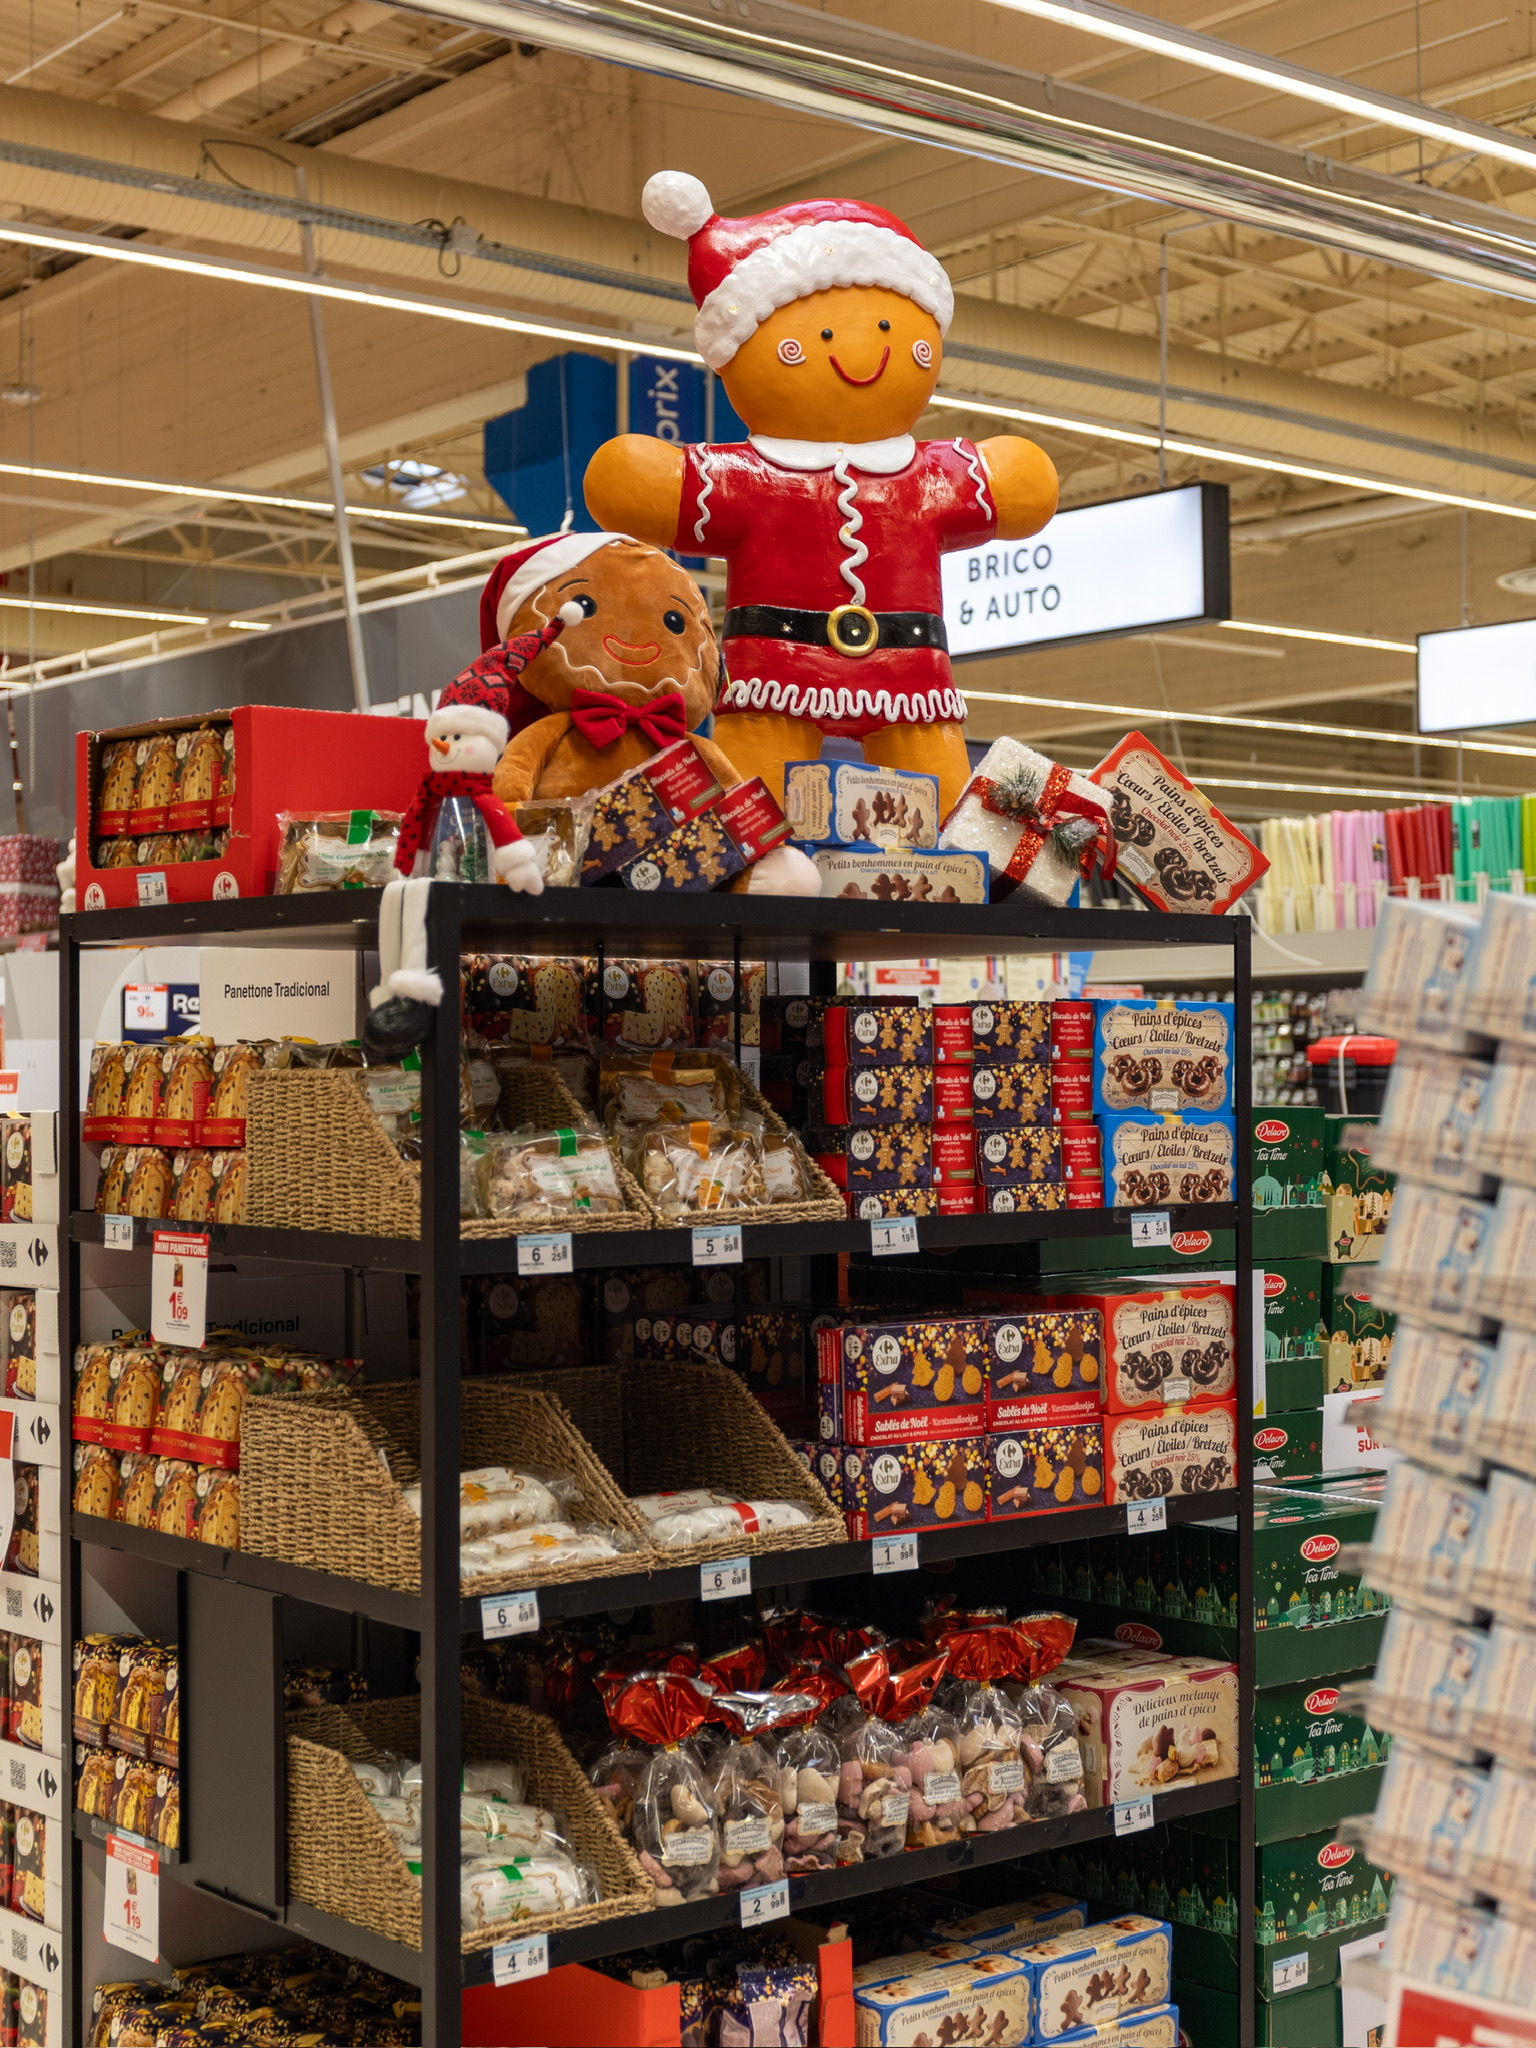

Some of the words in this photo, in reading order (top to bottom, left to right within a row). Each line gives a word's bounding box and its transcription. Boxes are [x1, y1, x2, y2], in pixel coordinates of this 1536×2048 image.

[968, 543, 1052, 582] BRICO
[960, 600, 974, 625] &
[986, 584, 1061, 621] AUTO
[846, 775, 860, 785] Petits
[861, 776, 890, 787] bonhommes
[897, 780, 909, 790] pain
[909, 782, 928, 797] d'épices
[719, 802, 745, 823] Biscuits
[743, 796, 753, 807] de
[751, 788, 766, 803] Noël
[1152, 775, 1187, 808] Pains
[1184, 804, 1225, 849] d'épices
[1117, 772, 1155, 801] Cœurs
[1157, 800, 1190, 835] Étoiles
[1193, 837, 1228, 884] Bretzels
[1141, 807, 1169, 831] Chocolat
[1167, 828, 1182, 842] noir
[1179, 840, 1195, 860] 25%
[827, 860, 851, 871] Petits
[852, 859, 902, 868] bonhommes
[903, 861, 914, 870] en
[914, 861, 934, 874] pain
[935, 861, 968, 876] d'épices
[636, 872, 660, 890] Extra
[224, 984, 272, 998] Panettone
[274, 981, 330, 997] Tradicional
[492, 977, 514, 988] Extra
[605, 980, 627, 991] Extra
[711, 982, 733, 993] Extra
[973, 1020, 991, 1029] Extra
[1132, 1012, 1162, 1027] Pains
[1164, 1011, 1202, 1029] d'épices
[856, 1027, 876, 1037] Extra
[1113, 1033, 1142, 1050] Cœurs
[1149, 1025, 1178, 1042] Étoiles
[1185, 1031, 1221, 1052] Bretzels
[856, 1085, 876, 1095] Extra
[975, 1085, 993, 1093] Extra
[932, 1133, 953, 1141] Biscuits
[953, 1133, 960, 1141] de
[960, 1132, 972, 1140] Noël
[1141, 1128, 1170, 1143] Pains
[1172, 1126, 1209, 1143] d'épices
[1258, 1123, 1288, 1137] Delacre
[853, 1144, 872, 1154] Extra
[986, 1148, 1005, 1157] Extra
[1122, 1149, 1150, 1166] Cœurs
[1192, 1144, 1226, 1166] Bretzels
[1254, 1147, 1269, 1161] Tea
[1267, 1147, 1288, 1161] Time
[884, 1229, 891, 1244] 1
[901, 1233, 910, 1243] 19
[1141, 1223, 1149, 1236] 4
[1156, 1227, 1163, 1236] 25
[154, 1241, 169, 1253] MINI
[169, 1242, 207, 1256] PANETTONE
[705, 1239, 714, 1253] 5
[723, 1243, 733, 1253] 99
[1174, 1232, 1209, 1249] Delacre
[531, 1247, 541, 1262] 6
[551, 1252, 561, 1261] 25
[1140, 1308, 1169, 1324] Pains
[1171, 1304, 1207, 1321] d'épices
[1266, 1301, 1285, 1314] Time
[1122, 1330, 1151, 1350] Cœurs
[1157, 1319, 1185, 1337] Étoiles
[1191, 1320, 1226, 1339] Bretzels
[997, 1344, 1020, 1355] Extra
[1151, 1339, 1174, 1352] Chocolat
[1175, 1337, 1185, 1346] noir
[1185, 1336, 1200, 1347] 25%
[875, 1355, 898, 1367] Extra
[997, 1405, 1021, 1418] Sablés
[1021, 1404, 1031, 1415] de
[1031, 1402, 1048, 1415] Noël
[874, 1418, 900, 1433] Sablés
[900, 1418, 910, 1430] de
[910, 1415, 929, 1428] Noël
[1140, 1424, 1169, 1440] Pains
[1171, 1419, 1209, 1436] d'épices
[1257, 1432, 1286, 1445] Delacre
[1121, 1447, 1151, 1467] Cœurs
[1157, 1435, 1185, 1454] Étoiles
[1192, 1436, 1228, 1455] Bretzels
[1000, 1459, 1021, 1471] Extra
[1150, 1455, 1175, 1469] Chocolat
[1174, 1453, 1186, 1463] noir
[1186, 1452, 1201, 1463] 25%
[875, 1473, 899, 1486] Extra
[1137, 1510, 1144, 1523] 4
[1152, 1513, 1159, 1521] 25
[884, 1547, 890, 1562] 1
[900, 1551, 909, 1561] 99
[1304, 1540, 1336, 1556] Delacre
[713, 1573, 723, 1588] 6
[731, 1575, 742, 1585] 69
[1301, 1568, 1319, 1584] Tea
[1317, 1565, 1339, 1580] Time
[497, 1608, 507, 1625] 6
[518, 1611, 529, 1622] 69
[1118, 1626, 1159, 1646] Delacre
[1132, 1694, 1178, 1716] Délicieux
[1179, 1690, 1221, 1703] mélange
[1138, 1717, 1150, 1729] de
[1151, 1708, 1178, 1727] pains
[1180, 1704, 1216, 1718] d'épices
[1305, 1722, 1323, 1738] Tea
[1321, 1718, 1344, 1735] Time
[1124, 1809, 1132, 1822] 4
[1138, 1811, 1147, 1820] 99
[1320, 1847, 1352, 1865] Delacre
[1318, 1874, 1335, 1892] Tea
[1333, 1871, 1354, 1887] Time
[753, 1899, 761, 1914] 2
[770, 1900, 780, 1909] 99
[507, 1955, 517, 1970] 4
[527, 1956, 538, 1966] 05
[1053, 1969, 1071, 1984] Petits
[1072, 1957, 1109, 1977] bonhommes
[1109, 1954, 1117, 1963] en
[1117, 1951, 1132, 1963] pain
[1133, 1946, 1157, 1958] d'épices
[1283, 1968, 1289, 1981] 7
[1295, 1968, 1303, 1978] 99
[900, 2011, 921, 2026] Petits
[921, 1997, 963, 2018] bonhommes
[963, 1995, 972, 2004] en
[972, 1991, 989, 2004] pain
[990, 1987, 1016, 1999] d'épices
